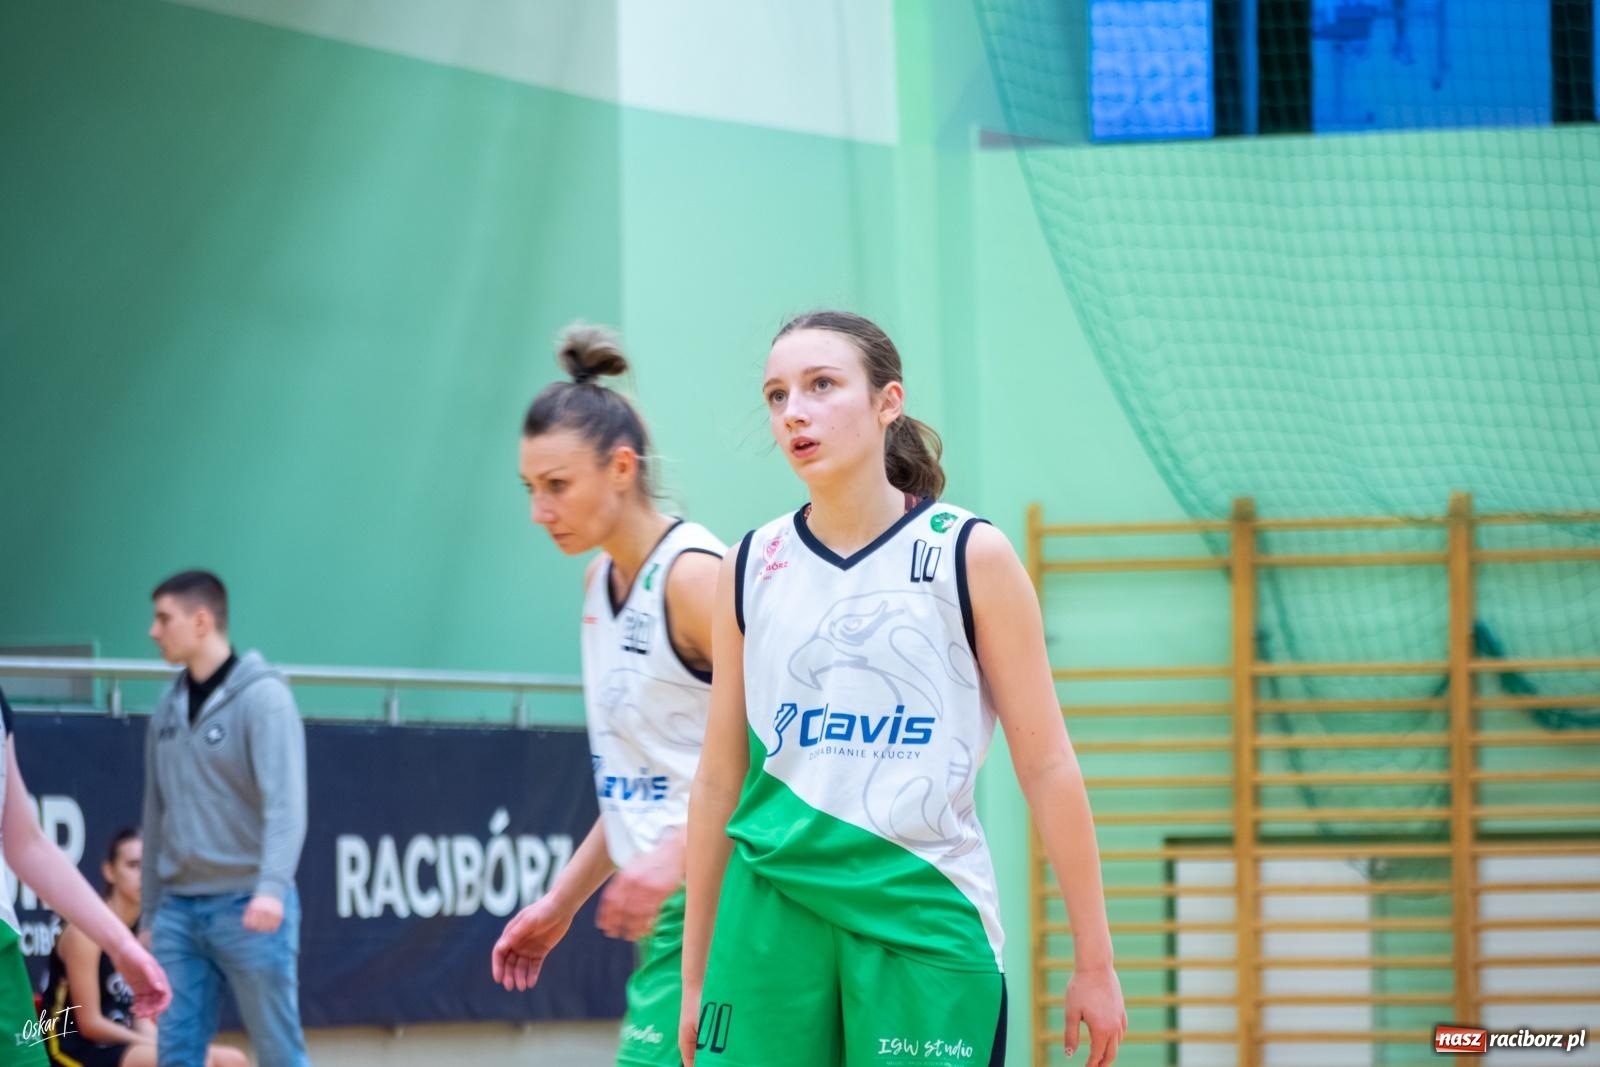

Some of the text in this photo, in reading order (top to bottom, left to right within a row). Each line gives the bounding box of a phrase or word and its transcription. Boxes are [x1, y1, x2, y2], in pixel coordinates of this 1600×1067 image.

[911, 538, 942, 583] 11
[799, 703, 936, 748] Clavis
[873, 751, 921, 760] KLUCZY
